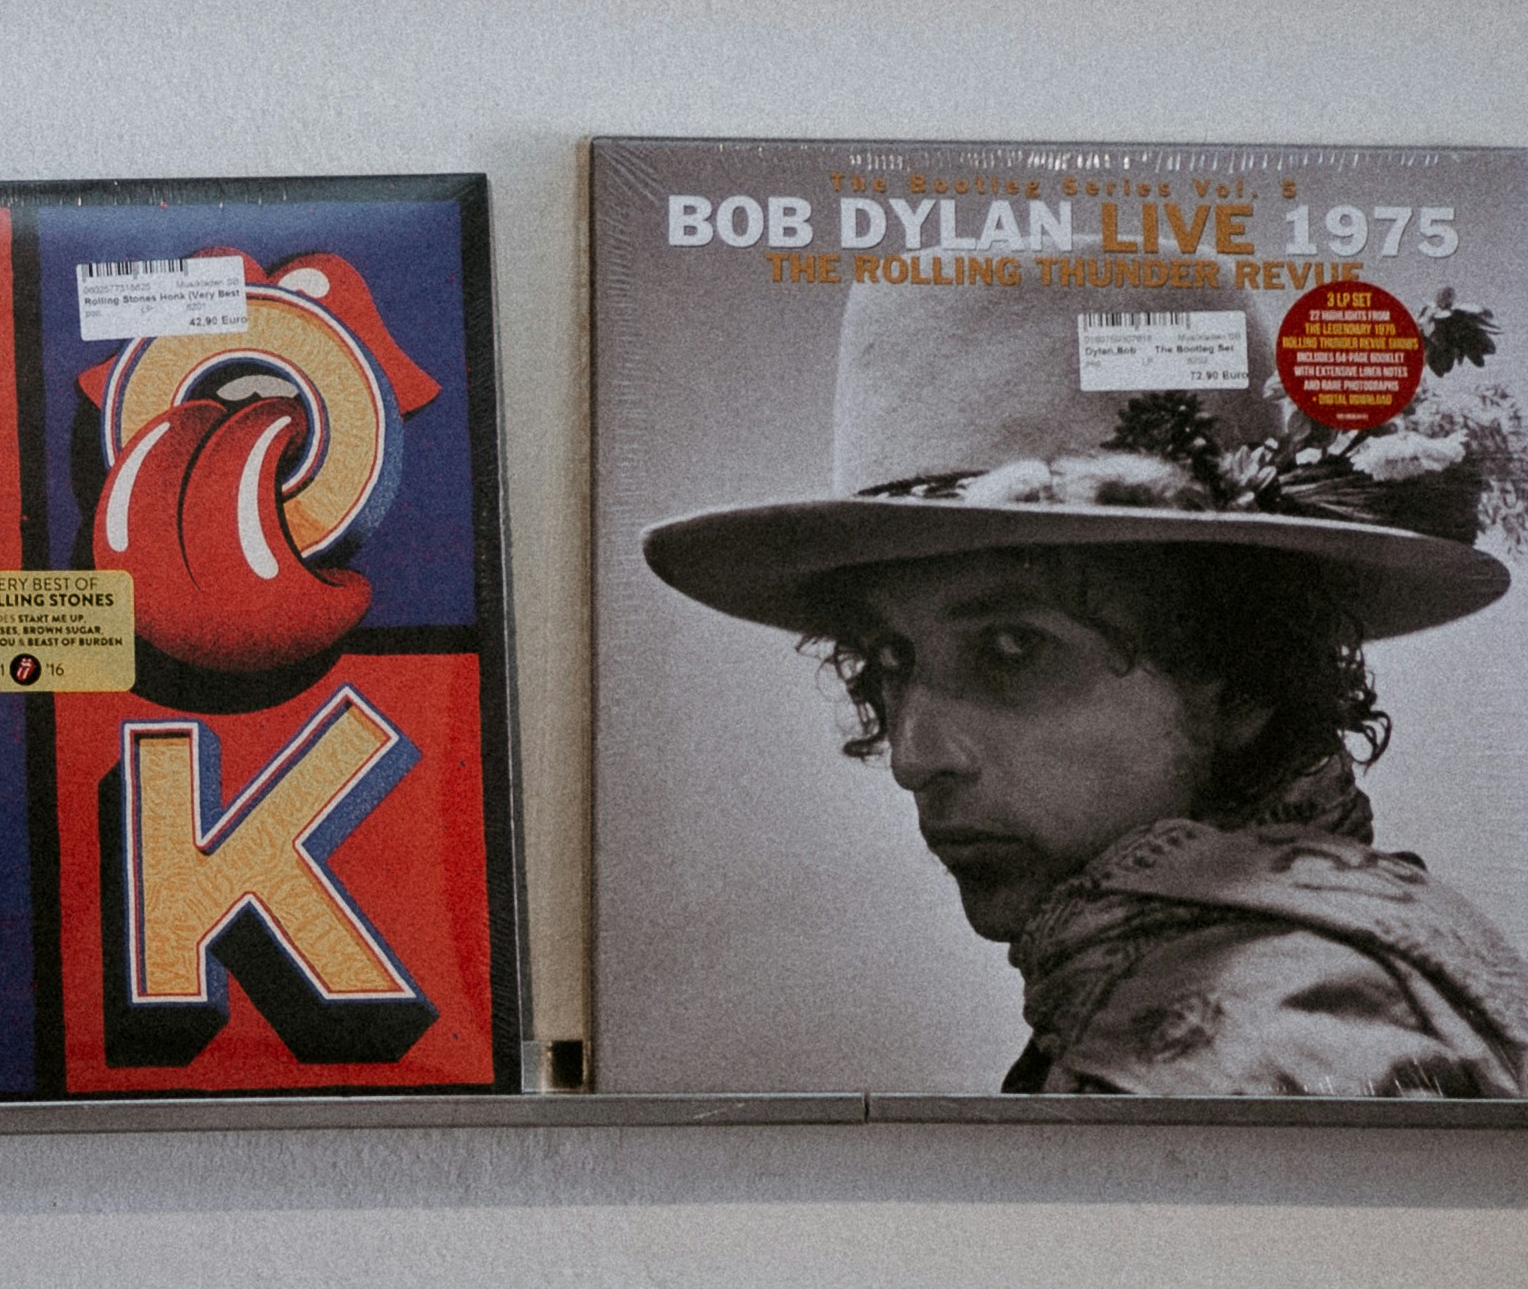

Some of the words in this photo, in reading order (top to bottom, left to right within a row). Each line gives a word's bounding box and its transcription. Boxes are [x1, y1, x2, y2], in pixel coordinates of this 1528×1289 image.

[830, 173, 887, 194] The
[909, 173, 1041, 198] Bootleg
[1061, 177, 1171, 197] Series
[1282, 180, 1297, 199] 5
[668, 194, 814, 248] BOB
[840, 196, 1073, 251] DYLAN
[1101, 201, 1255, 255] LIVE
[1285, 204, 1460, 258] 1975
[765, 252, 841, 284] THE
[855, 255, 1023, 287] ROLLING
[1037, 257, 1220, 289] THUNDER
[84, 297, 120, 306] Rolling
[123, 294, 157, 304] Stones
[160, 292, 185, 302] Honk
[188, 290, 215, 301] (Very
[218, 289, 240, 298] Best
[1327, 293, 1335, 307] 3
[1337, 292, 1351, 307] LP
[1353, 292, 1372, 308] SET
[33, 577, 70, 591] BEST
[75, 577, 98, 591] OF
[49, 593, 114, 607] STONES
[17, 614, 49, 624] START
[52, 614, 67, 623] ME
[69, 614, 86, 624] UP,
[23, 626, 62, 635] BROWN
[65, 626, 104, 635] SUGAR,
[27, 638, 59, 646] BEAST
[61, 638, 77, 646] OF
[79, 637, 123, 646] BURDEN
